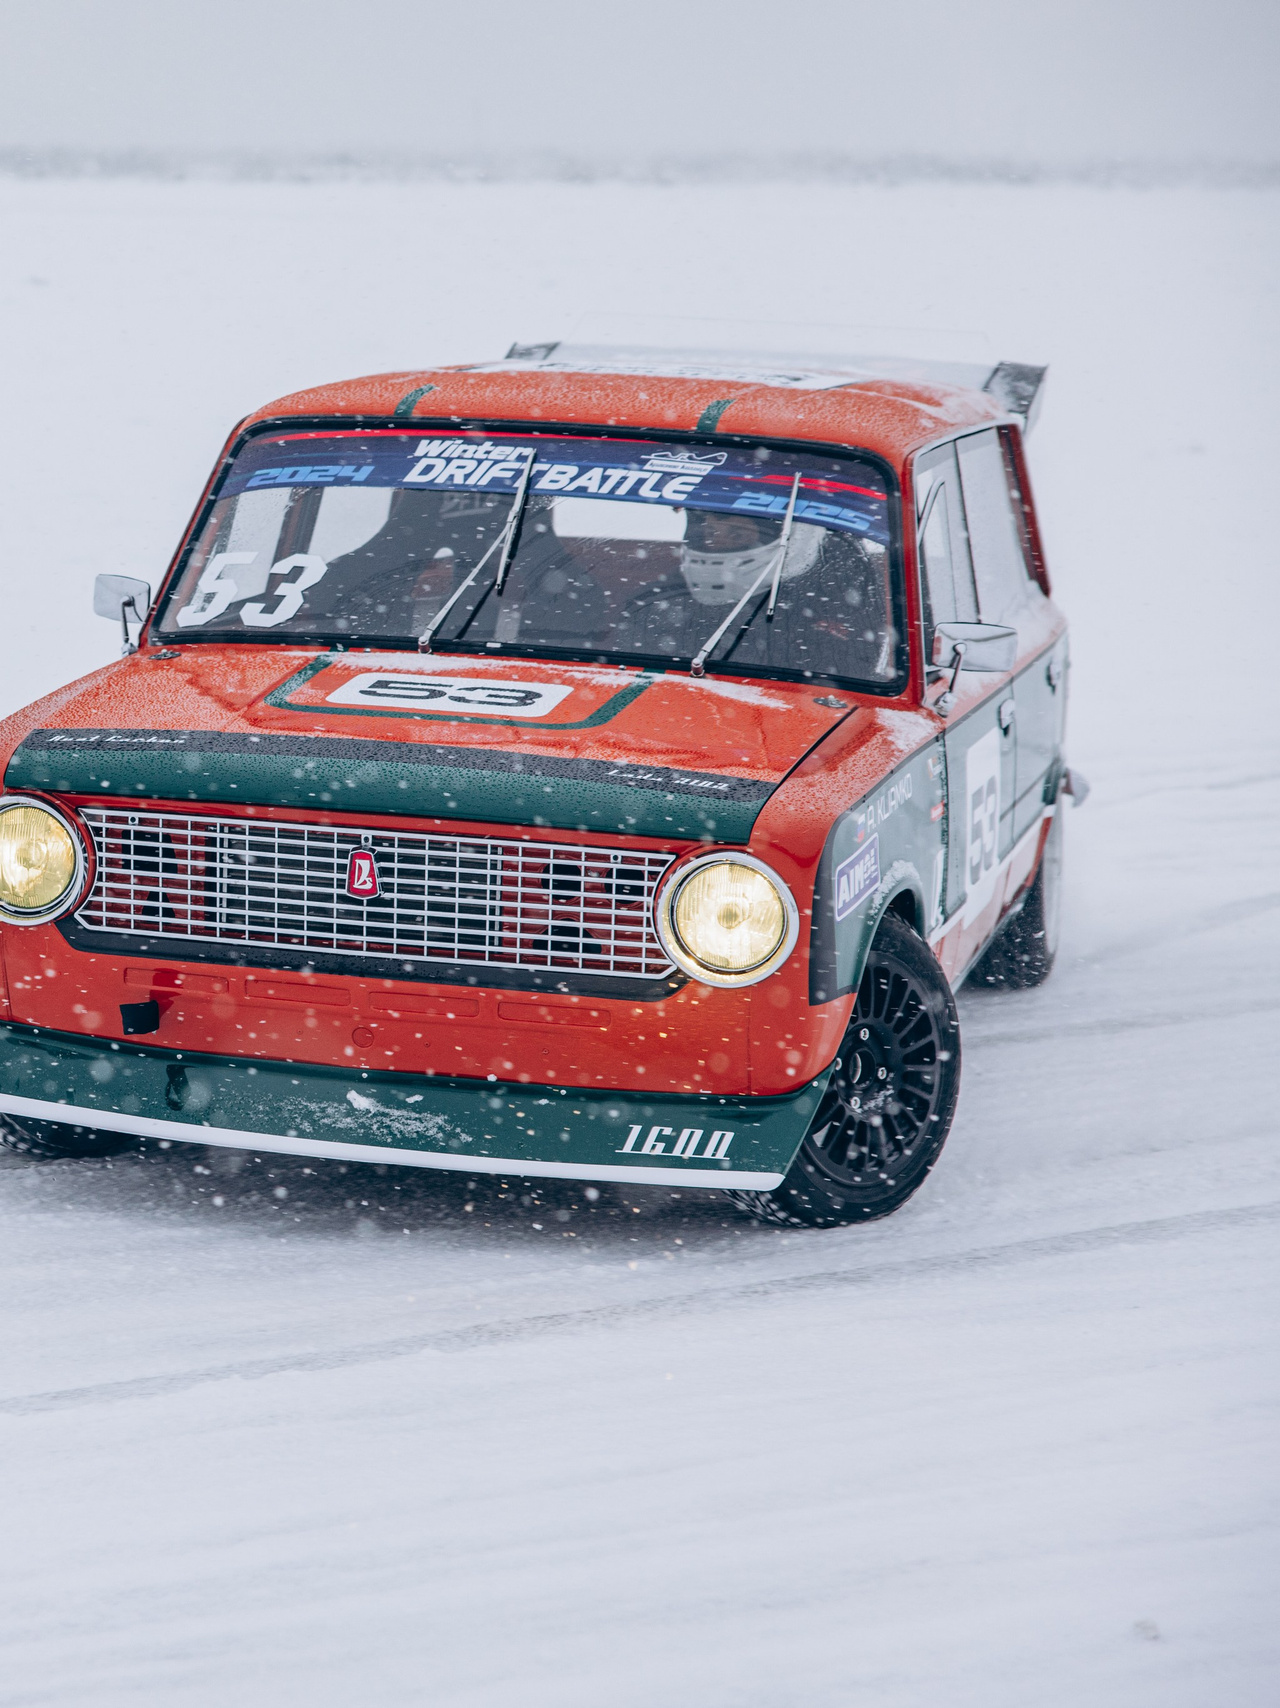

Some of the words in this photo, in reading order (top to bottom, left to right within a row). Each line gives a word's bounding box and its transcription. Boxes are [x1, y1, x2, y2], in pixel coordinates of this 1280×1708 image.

[413, 439, 533, 461] Winter
[246, 465, 376, 488] 2024
[731, 491, 876, 531] 2025
[175, 551, 328, 628] 53
[359, 679, 543, 707] 53
[970, 774, 997, 886] 53
[615, 1124, 735, 1160] 1600
